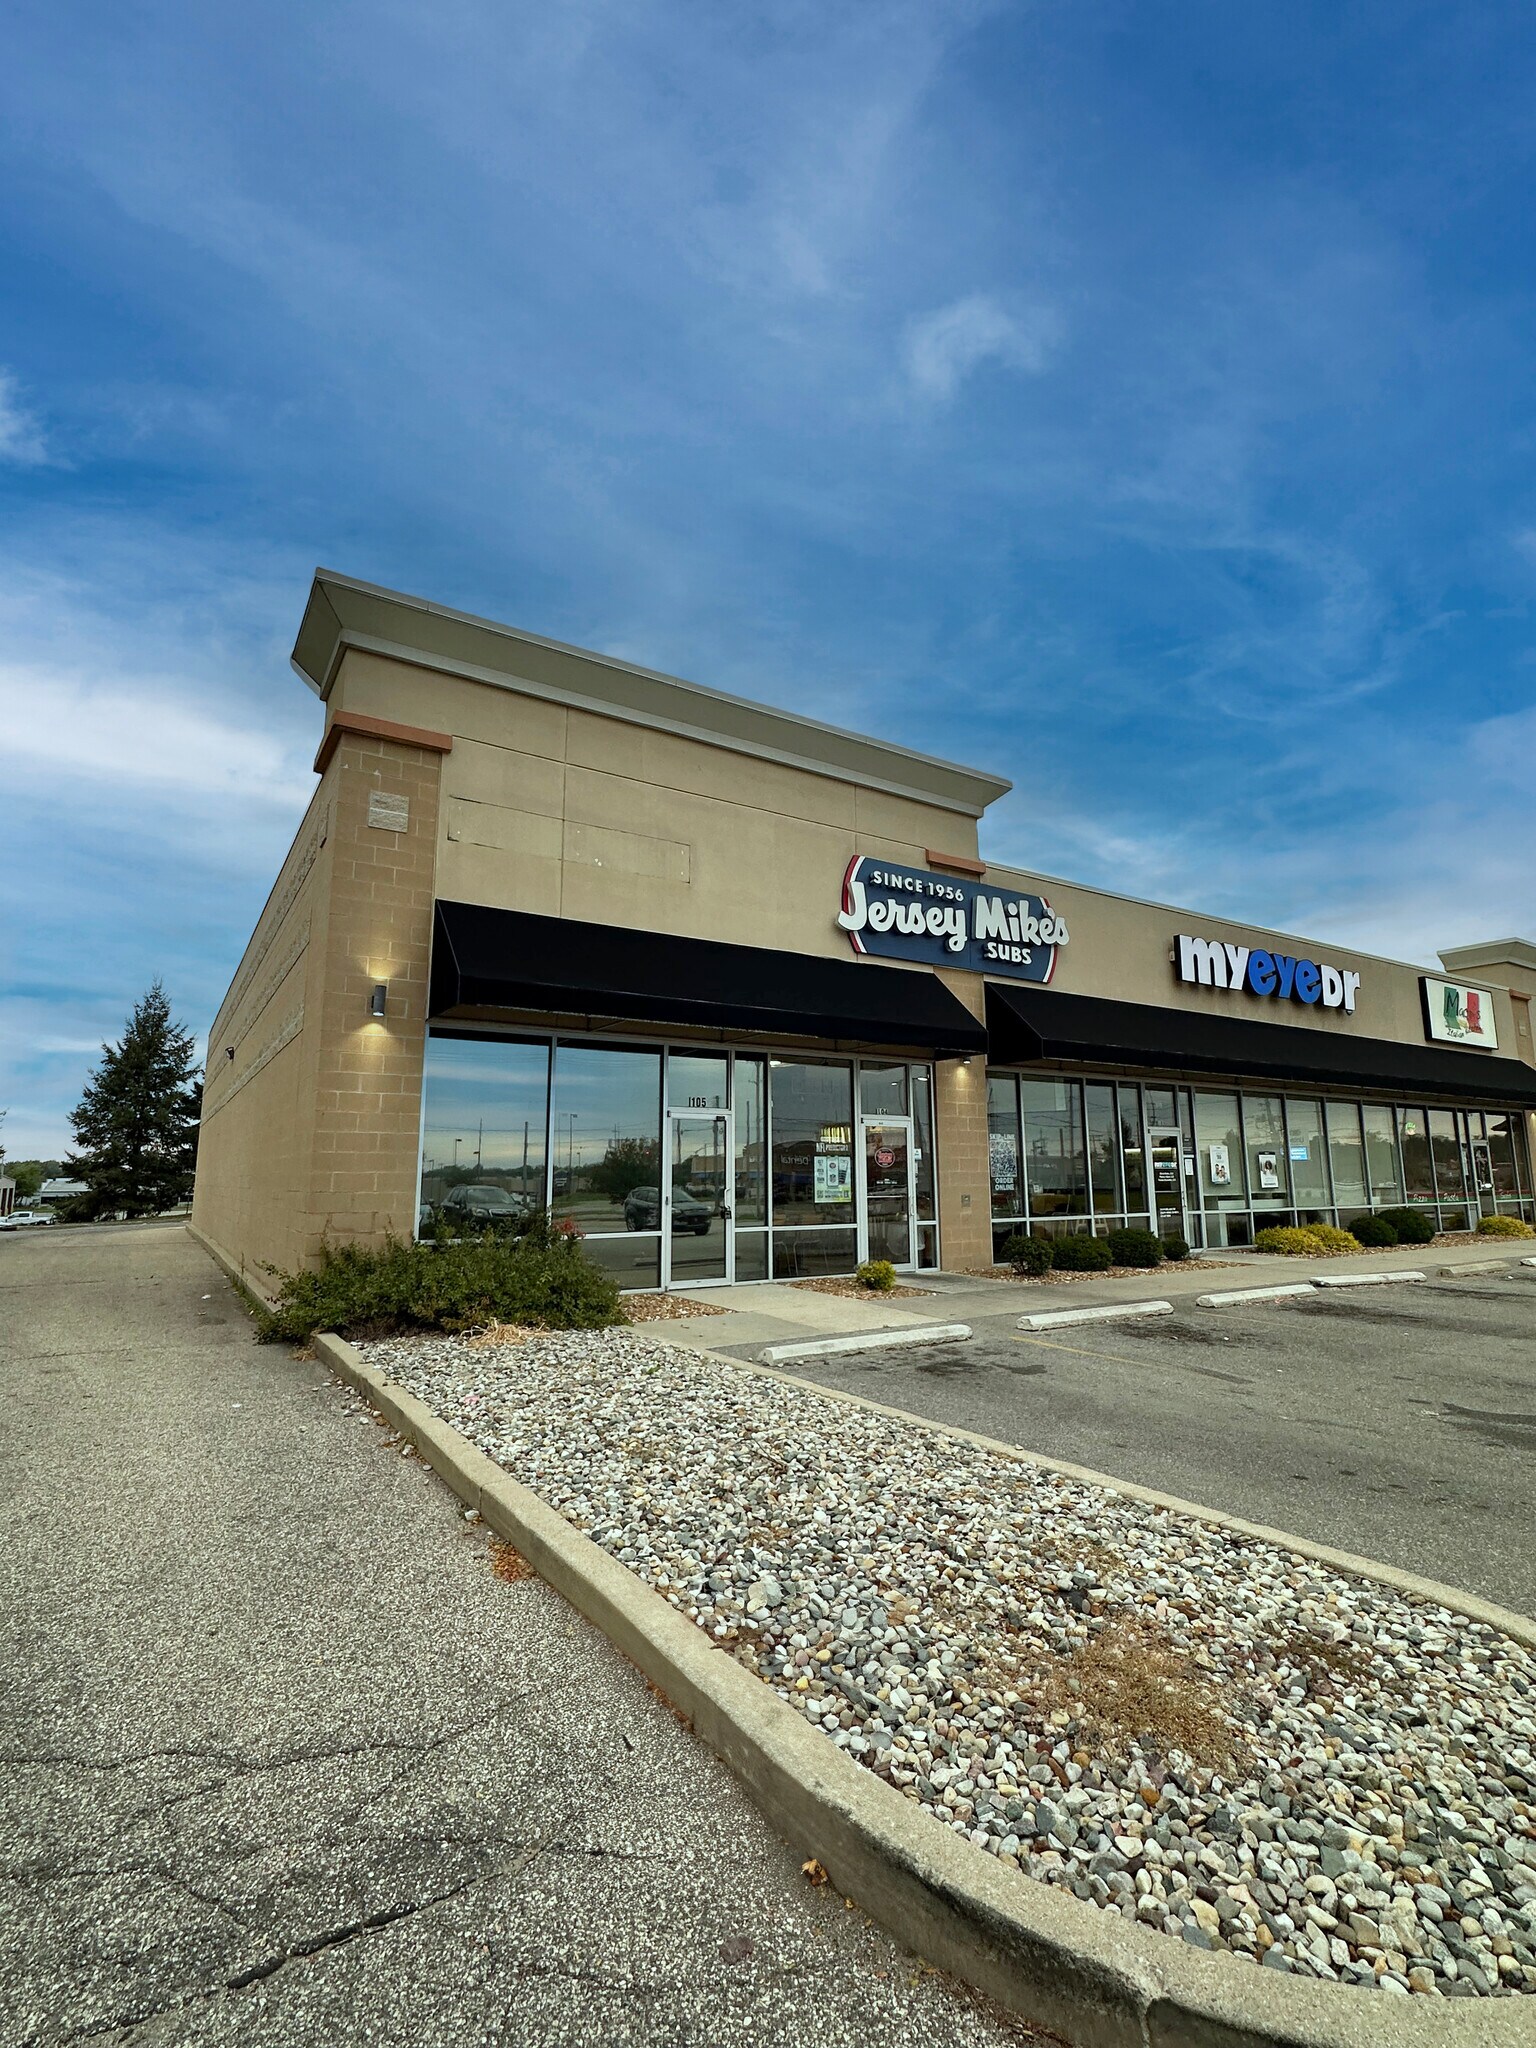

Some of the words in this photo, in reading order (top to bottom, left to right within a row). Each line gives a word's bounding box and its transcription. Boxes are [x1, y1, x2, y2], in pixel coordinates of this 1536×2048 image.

[872, 870, 923, 893] SINCE
[928, 882, 964, 902] 1956
[838, 881, 968, 952] Jersey
[974, 895, 1070, 946] Mike's
[986, 942, 1032, 965] SUBS
[688, 1097, 707, 1108] 1105
